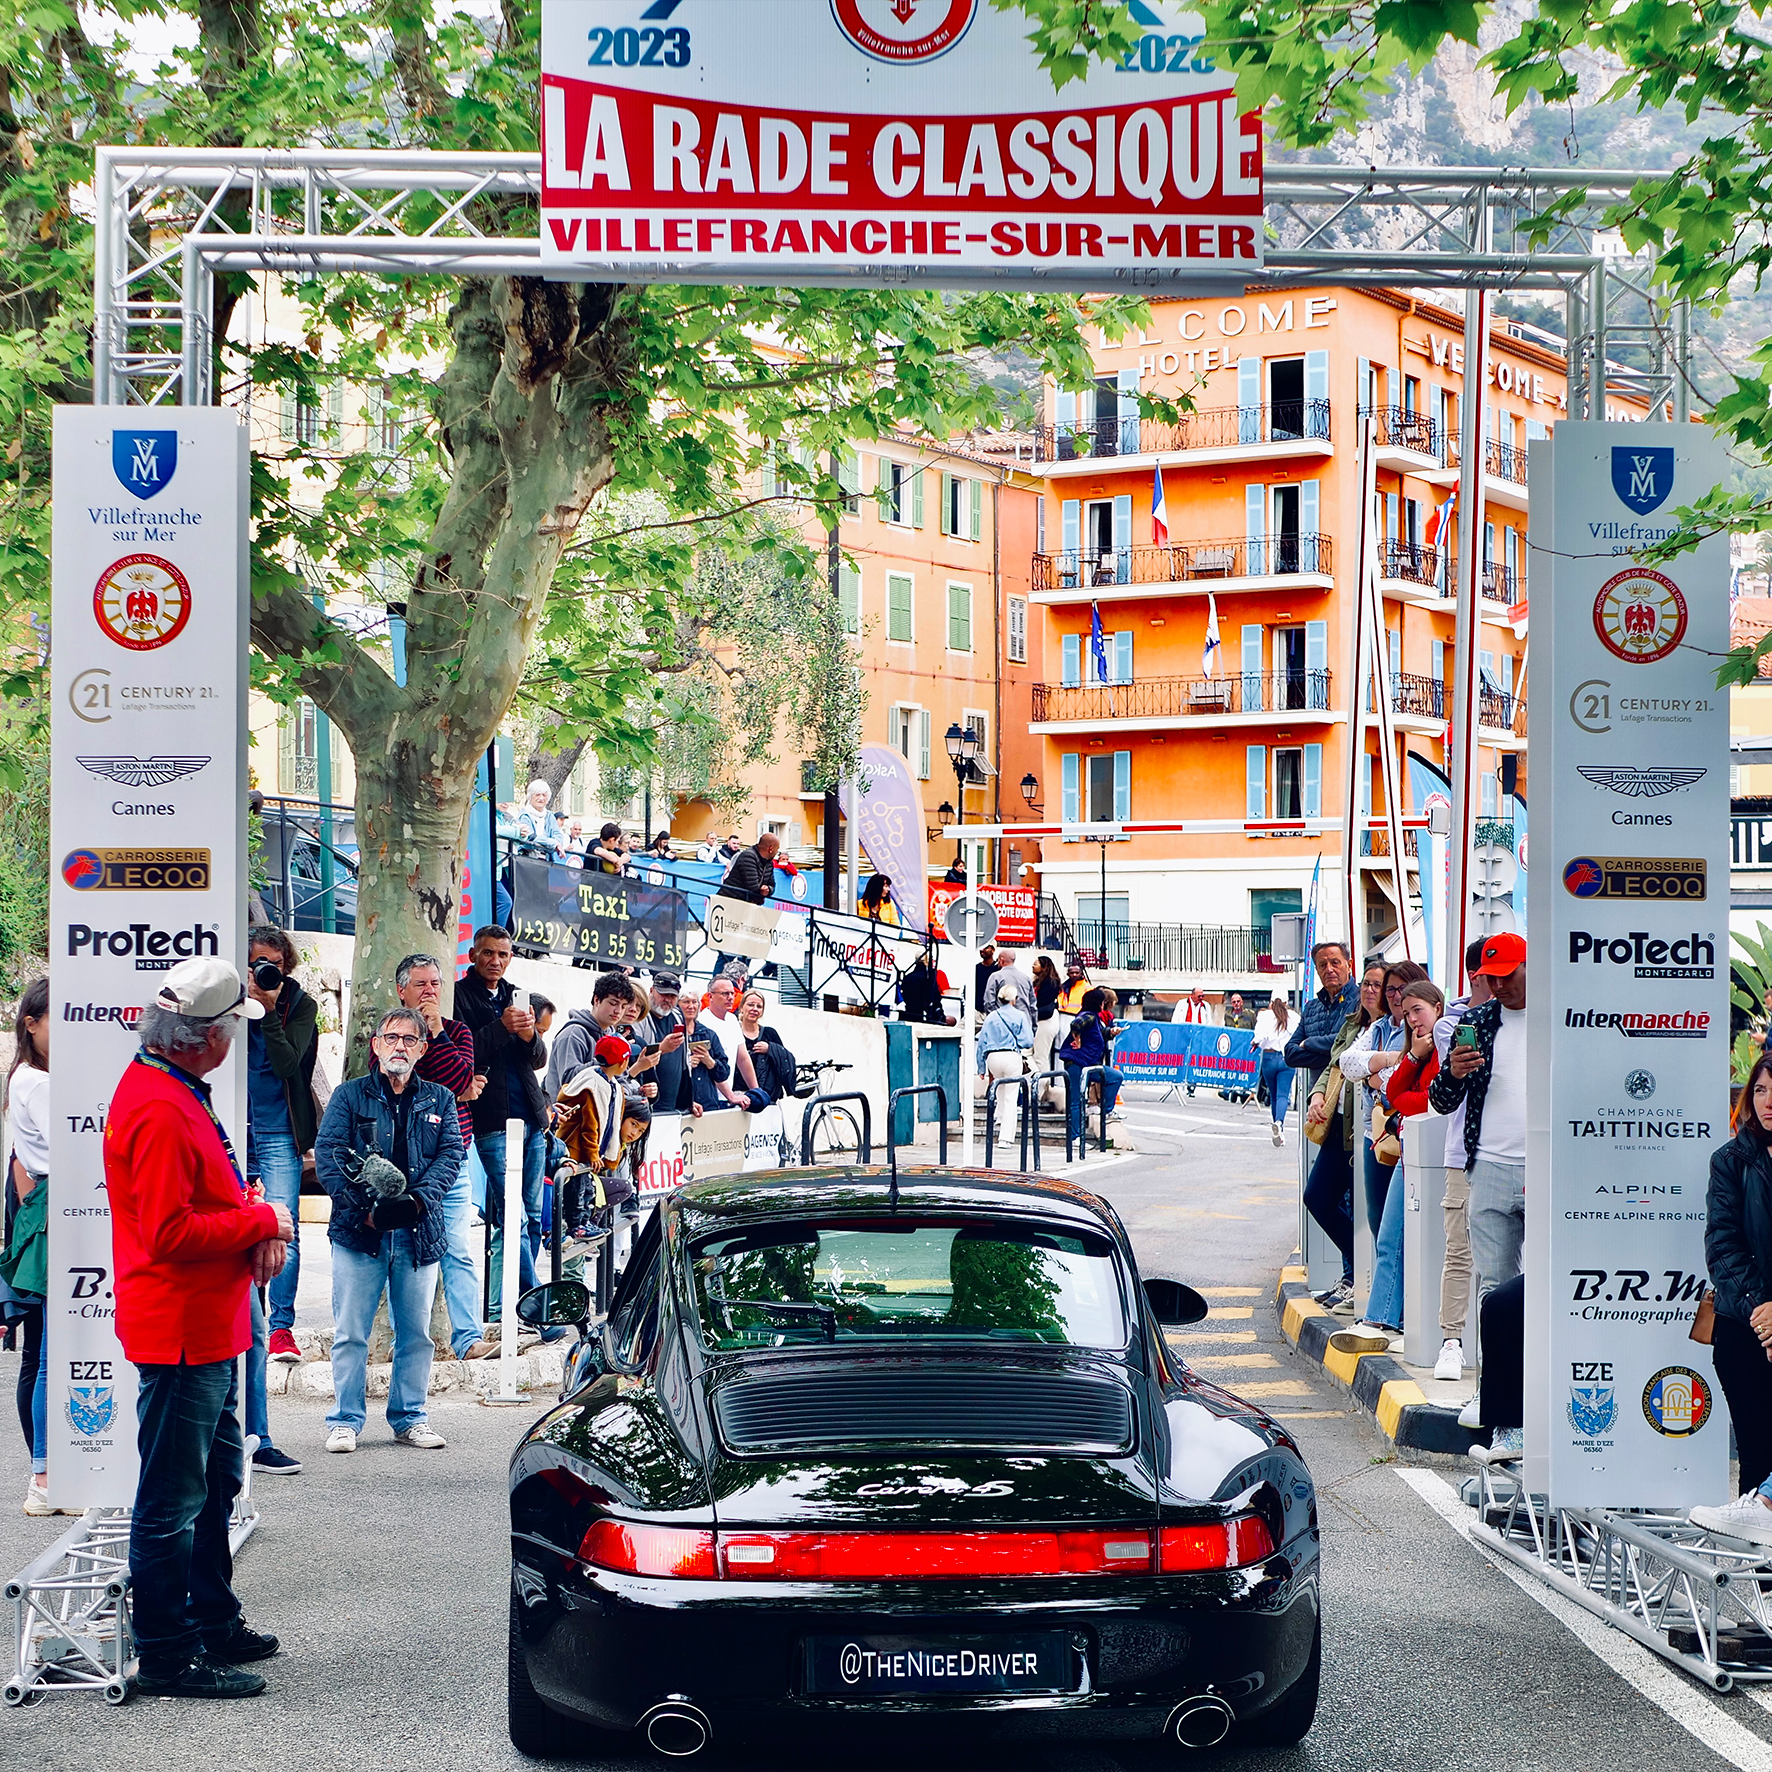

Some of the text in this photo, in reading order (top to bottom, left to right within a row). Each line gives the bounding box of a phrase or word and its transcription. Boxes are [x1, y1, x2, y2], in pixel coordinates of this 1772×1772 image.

[587, 27, 691, 68] 2023
[857, 27, 951, 56] Villefranche-sur-Mer
[543, 84, 1260, 208] LA RADE CLASSIQUE
[547, 217, 1258, 259] VILLEFRANCHE-SUR-MER
[1139, 346, 1239, 378] HOTEL
[87, 507, 202, 525] Villefranche
[112, 527, 176, 541] sur Mer
[1587, 522, 1684, 540] Villefranc
[1595, 579, 1617, 614] AUTOMOBILE
[1615, 571, 1631, 582] CLUB
[1641, 570, 1656, 578] NICE
[1655, 574, 1664, 582] ET
[1647, 653, 1660, 661] 1896
[120, 687, 196, 698] CENTURY
[122, 703, 196, 712] Lafage Transactions
[1619, 698, 1691, 711] CENTURY
[1620, 714, 1692, 723] Lafage Transactions
[111, 801, 175, 816] Cannes
[1611, 810, 1673, 826] Cannes
[105, 852, 207, 861] CARROSSERIE
[1605, 860, 1703, 871] CARROSSERIE
[105, 867, 206, 887] LECOQ
[1607, 876, 1703, 897] LECOQ
[578, 884, 631, 921] Taxi
[1016, 892, 1033, 906] CLUB
[580, 928, 600, 953] 93
[608, 933, 627, 958] 55
[635, 938, 655, 963] 55
[664, 943, 683, 967] 55
[1636, 969, 1712, 977] MONTE-CARLO
[63, 1002, 144, 1029] Interm
[1565, 1008, 1711, 1033] Intermarché
[1117, 1052, 1185, 1067] LA RADE CLASSIQUE
[1198, 1055, 1217, 1069] RADE
[1218, 1057, 1257, 1073] CLASSIQUE
[1123, 1065, 1178, 1076] VILLEFRANCHE SUR MER
[1192, 1068, 1249, 1081] VILLEFRANCHE SUR MER
[1597, 1108, 1683, 1117] CHAMPAGNE
[67, 1116, 106, 1133] TAI
[1568, 1120, 1711, 1138] TAITTINGER
[694, 1139, 742, 1156] Lafage Transactions
[743, 1133, 750, 1159] 9
[750, 1133, 780, 1149] AGENES
[1595, 1185, 1682, 1195] ALPINE
[63, 1208, 110, 1216] CENTRE
[1564, 1211, 1705, 1221] CENTRE ALPINE RRG NIC
[68, 1267, 113, 1299] B.
[80, 1304, 116, 1319] Chr
[69, 1361, 113, 1380] EZE
[1571, 1362, 1614, 1381] EZE
[1675, 1366, 1688, 1374] DES
[857, 1480, 1015, 1497] Carrera 4S
